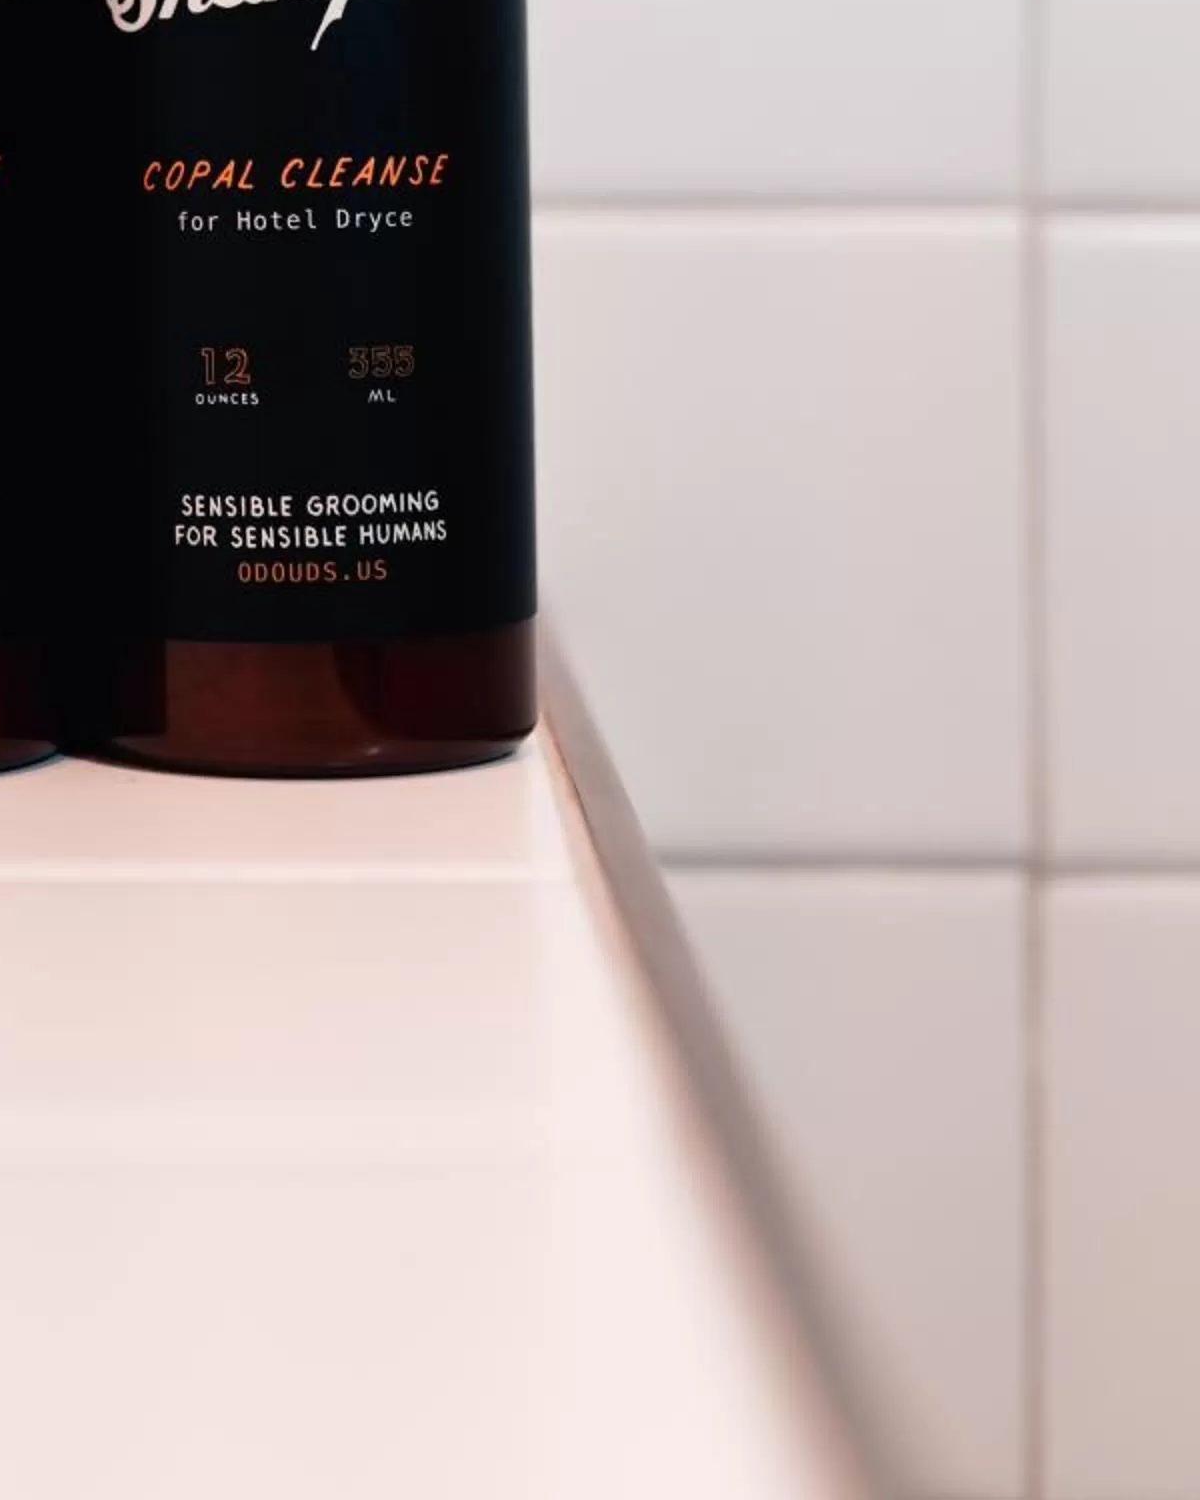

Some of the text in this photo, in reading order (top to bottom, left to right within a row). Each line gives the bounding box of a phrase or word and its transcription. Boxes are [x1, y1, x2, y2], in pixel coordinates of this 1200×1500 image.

[143, 153, 449, 191] COPAL CLEANSE
[177, 207, 413, 233] for Hotel Dryce
[200, 347, 251, 386] 12
[348, 345, 415, 379] 355
[195, 392, 260, 405] OUNCES
[367, 388, 396, 403] ML
[181, 490, 439, 518] SENSIBLE GROOMING
[175, 519, 447, 549] FOR SENSIBLE HUMANS
[237, 559, 387, 583] ODOUDS.US
